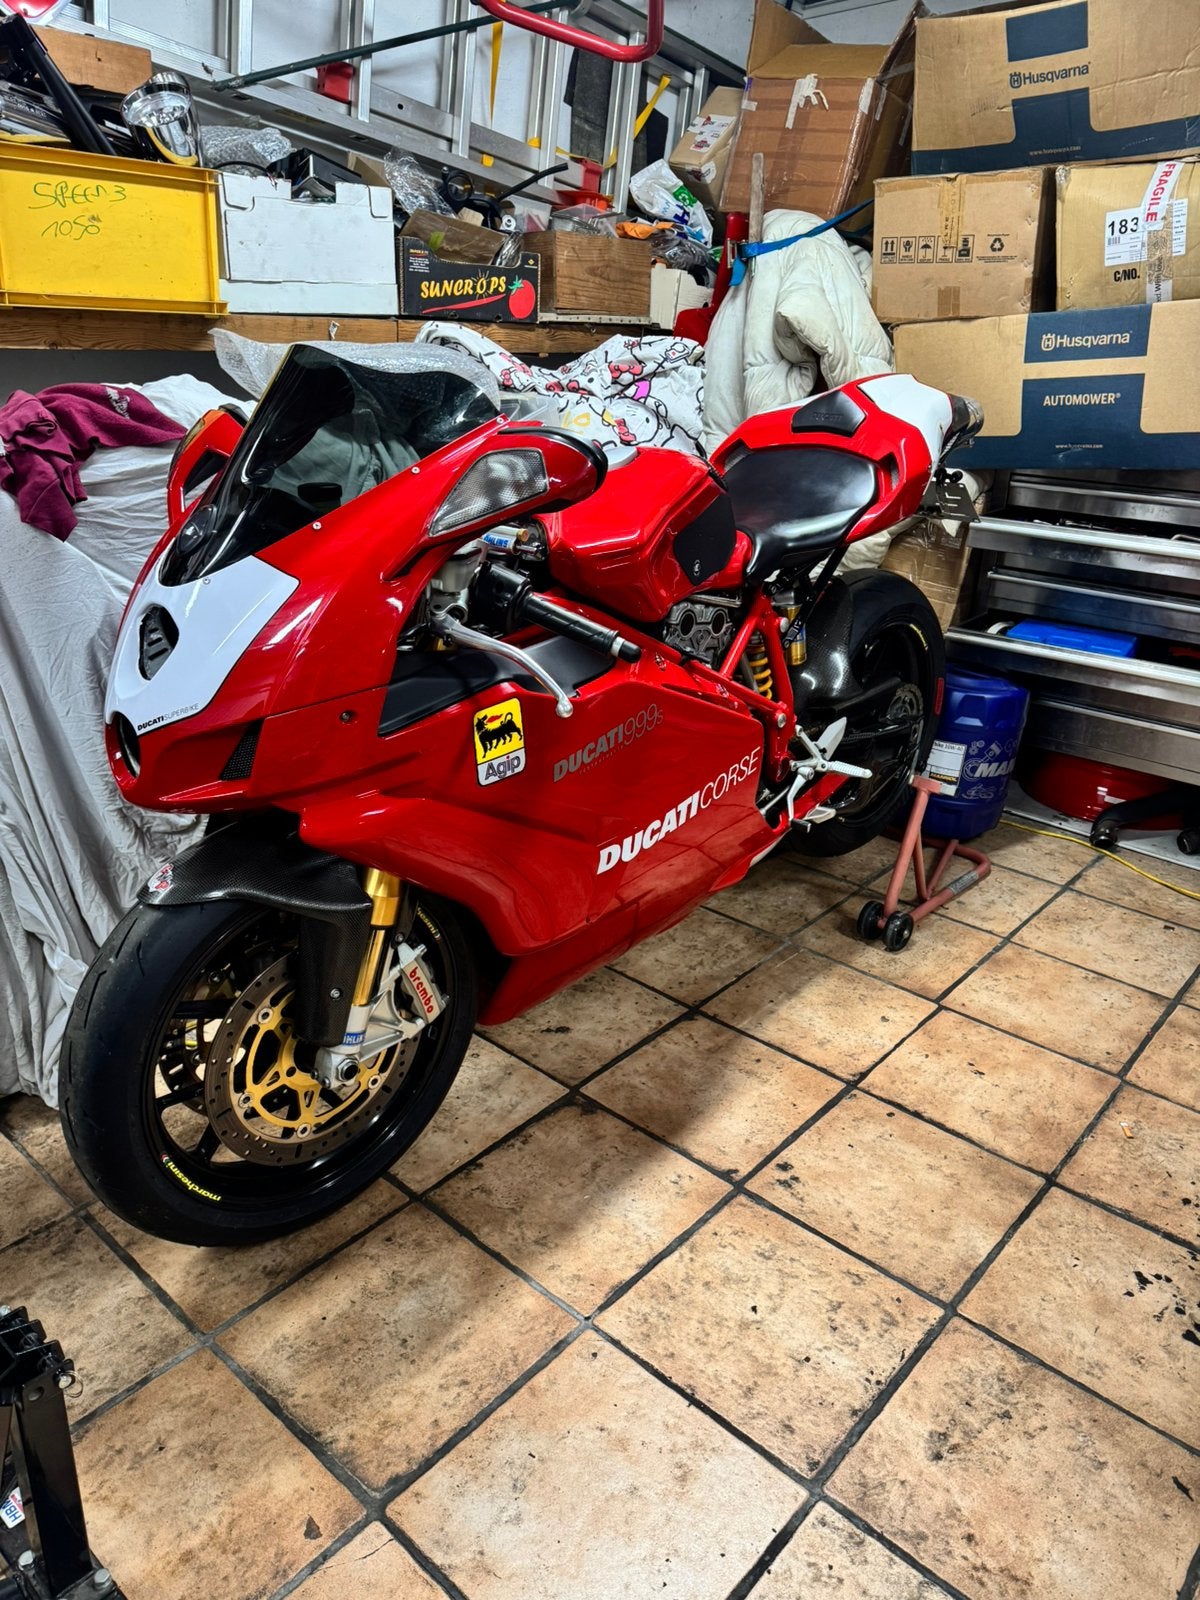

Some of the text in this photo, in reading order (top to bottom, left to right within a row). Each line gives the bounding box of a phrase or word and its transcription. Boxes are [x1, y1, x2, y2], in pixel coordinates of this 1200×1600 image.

[1023, 64, 1089, 85] Husqvarna
[1146, 163, 1177, 222] FRAGILE
[420, 276, 507, 299] SUNCROPS
[1113, 268, 1140, 283] C/NO.
[1056, 333, 1131, 348] Husqvarna
[137, 715, 164, 731] DUCATI
[553, 724, 624, 783] DUCATI
[484, 755, 521, 780] Agip
[597, 790, 700, 875] DUCATI
[700, 746, 761, 809] CORSE
[409, 966, 434, 1013] brembo
[168, 1162, 221, 1201] marchesini
